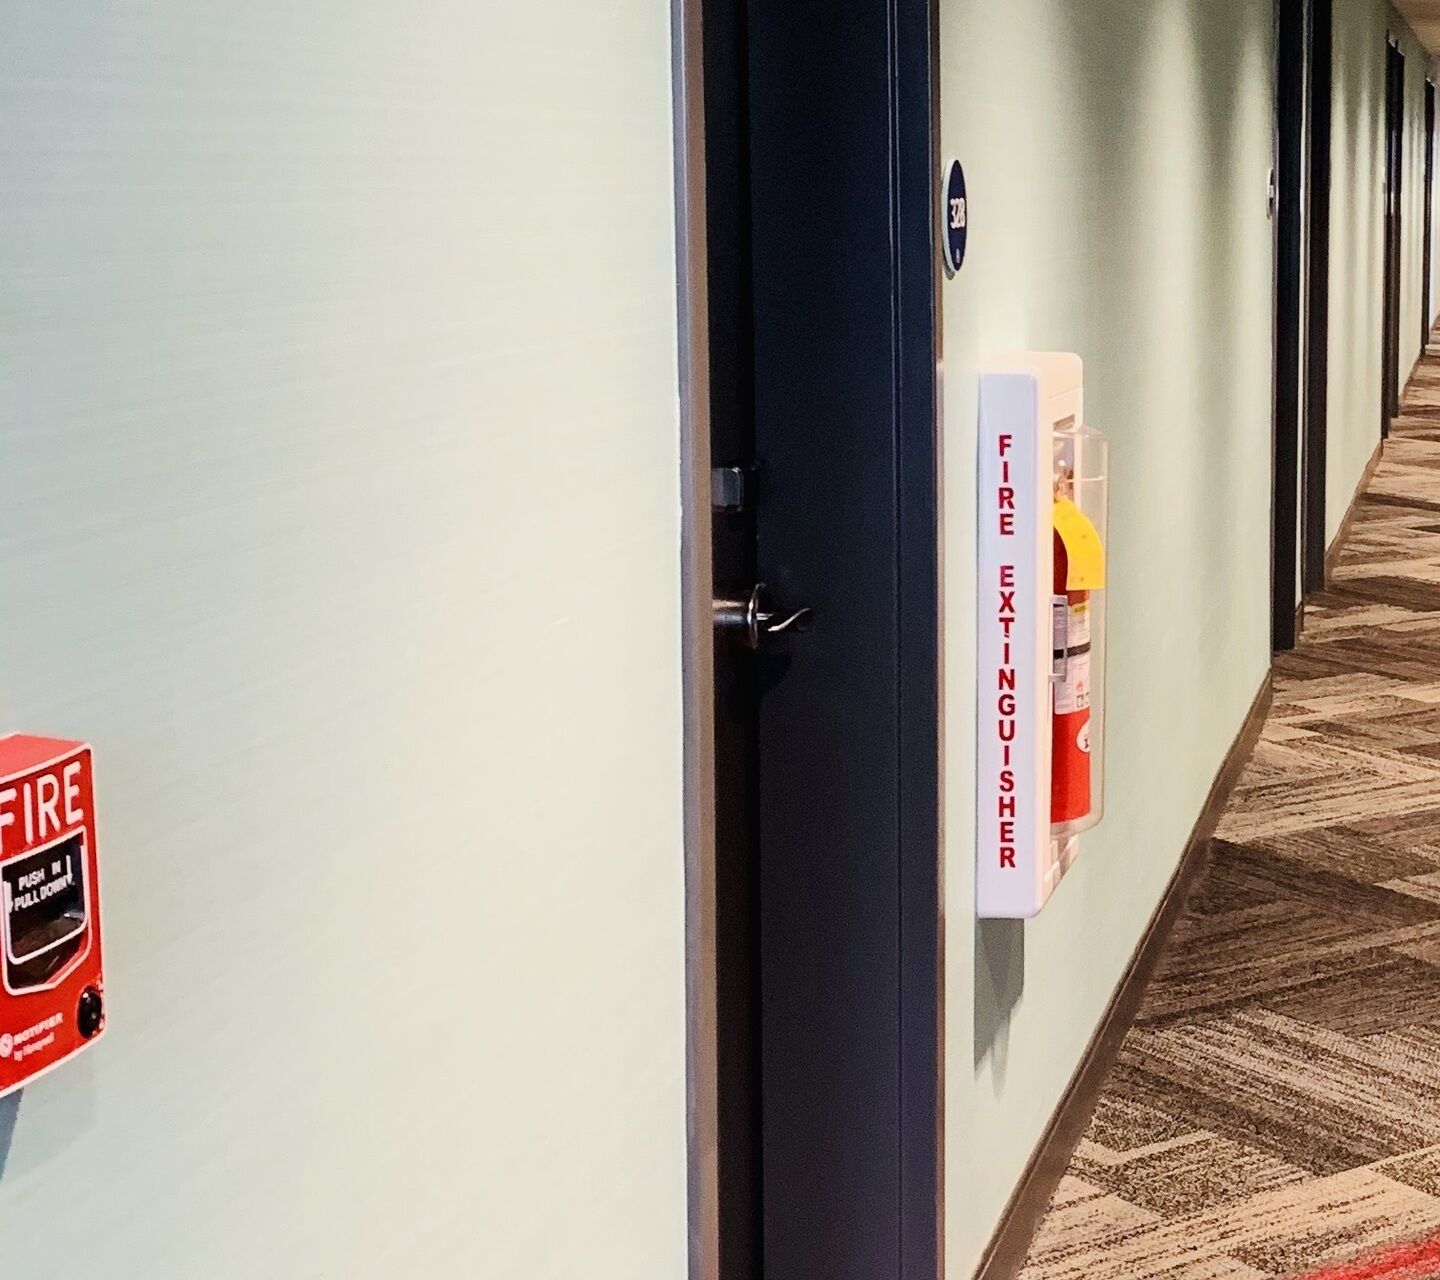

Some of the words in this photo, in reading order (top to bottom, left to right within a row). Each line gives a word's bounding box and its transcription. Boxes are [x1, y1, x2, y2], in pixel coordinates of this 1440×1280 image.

[998, 434, 1014, 535] FIRE
[998, 565, 1015, 868] EXTINGUISHER
[0, 761, 83, 854] FIRE
[15, 890, 40, 911] PULL
[40, 875, 67, 900] DOWN
[19, 868, 45, 890] PUSH
